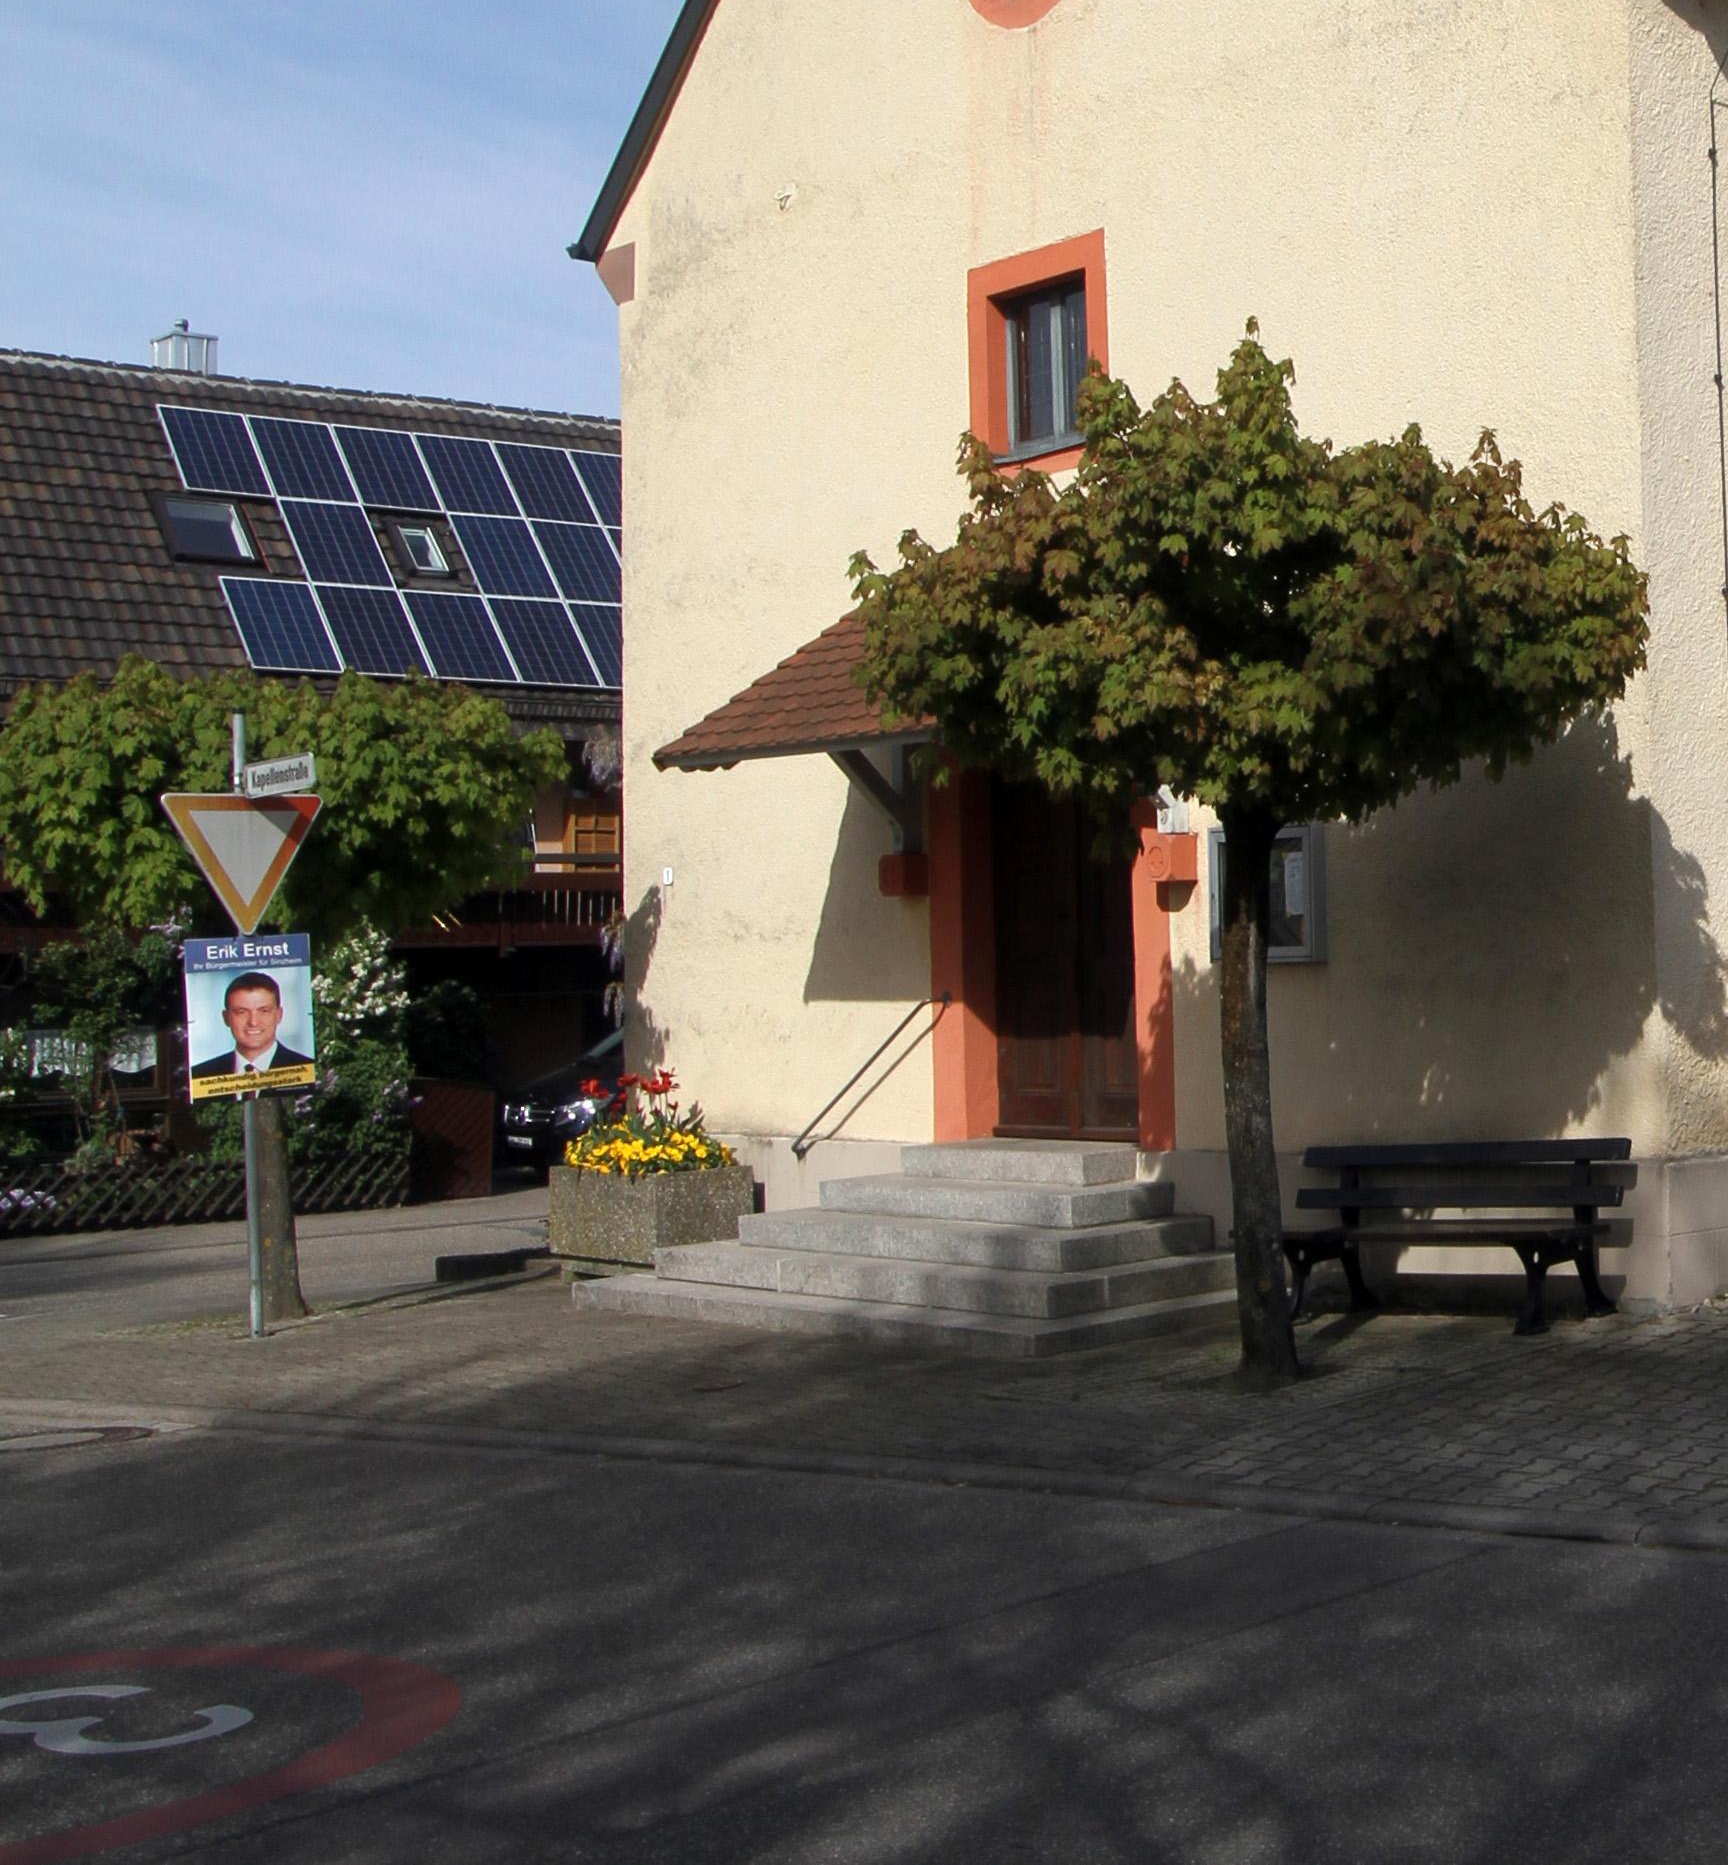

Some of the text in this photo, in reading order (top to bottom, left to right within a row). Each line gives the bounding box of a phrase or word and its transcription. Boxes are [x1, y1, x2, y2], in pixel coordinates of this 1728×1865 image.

[251, 760, 309, 791] Kapellenstraße
[206, 942, 290, 960] Erik Ernst
